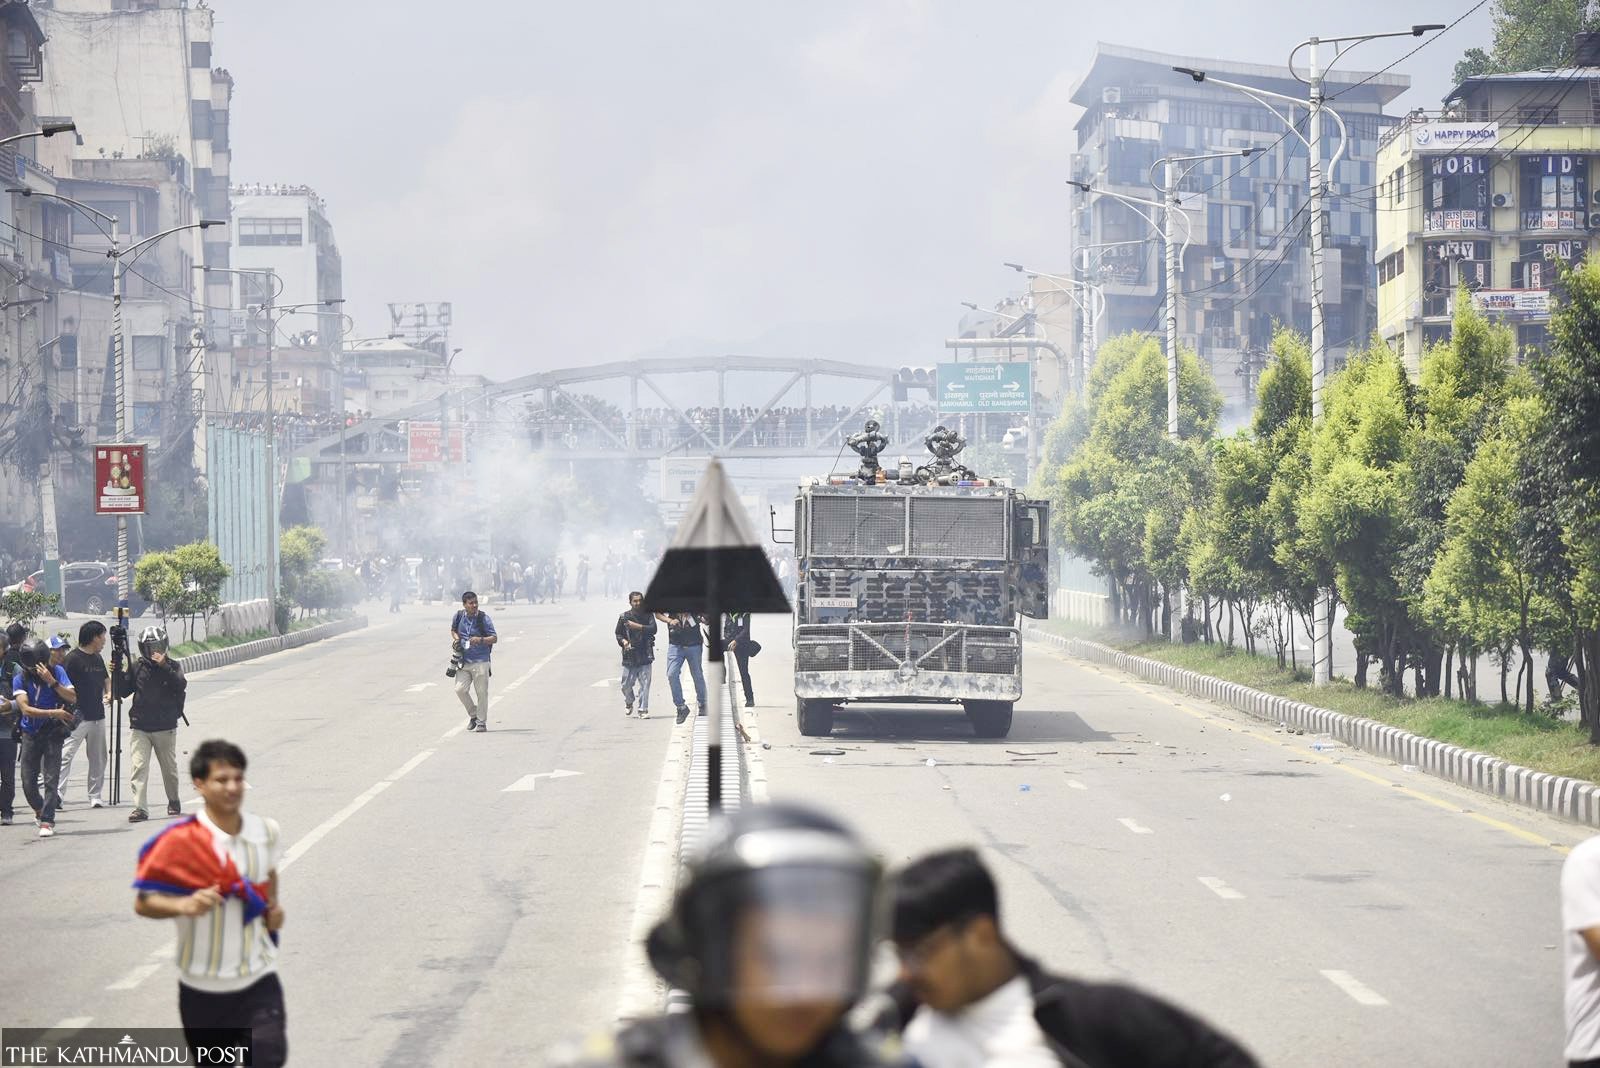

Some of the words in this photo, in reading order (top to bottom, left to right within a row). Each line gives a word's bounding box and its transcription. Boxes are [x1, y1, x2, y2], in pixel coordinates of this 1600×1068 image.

[1434, 130, 1464, 139] HAPPY
[1466, 129, 1496, 139] PANDA
[1445, 220, 1460, 229] PTE
[1462, 218, 1475, 228] UK
